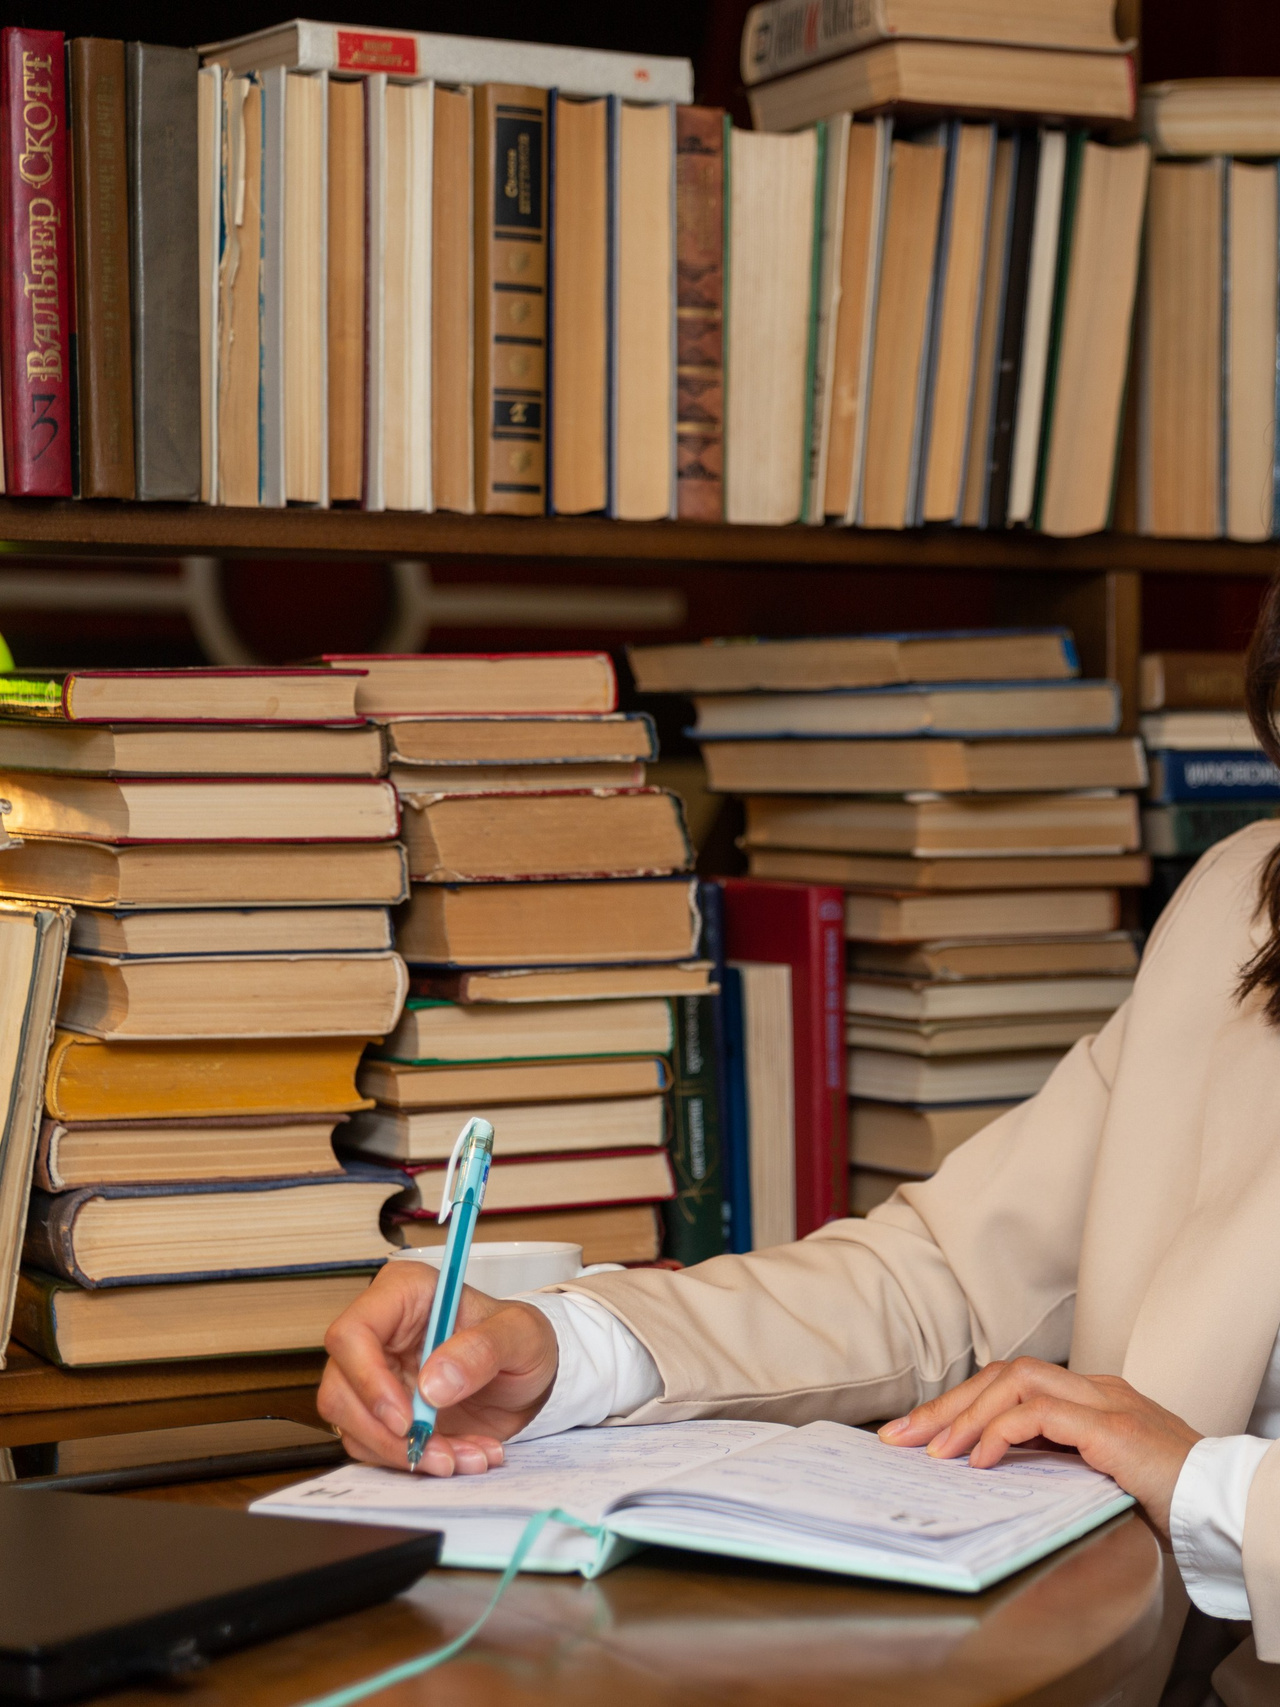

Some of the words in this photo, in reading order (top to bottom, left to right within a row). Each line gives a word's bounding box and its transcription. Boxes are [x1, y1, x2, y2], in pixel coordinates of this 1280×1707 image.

[19, 50, 55, 188] СКОТТ
[26, 198, 63, 382] ВАЛЬТЕР
[31, 393, 59, 462] 3
